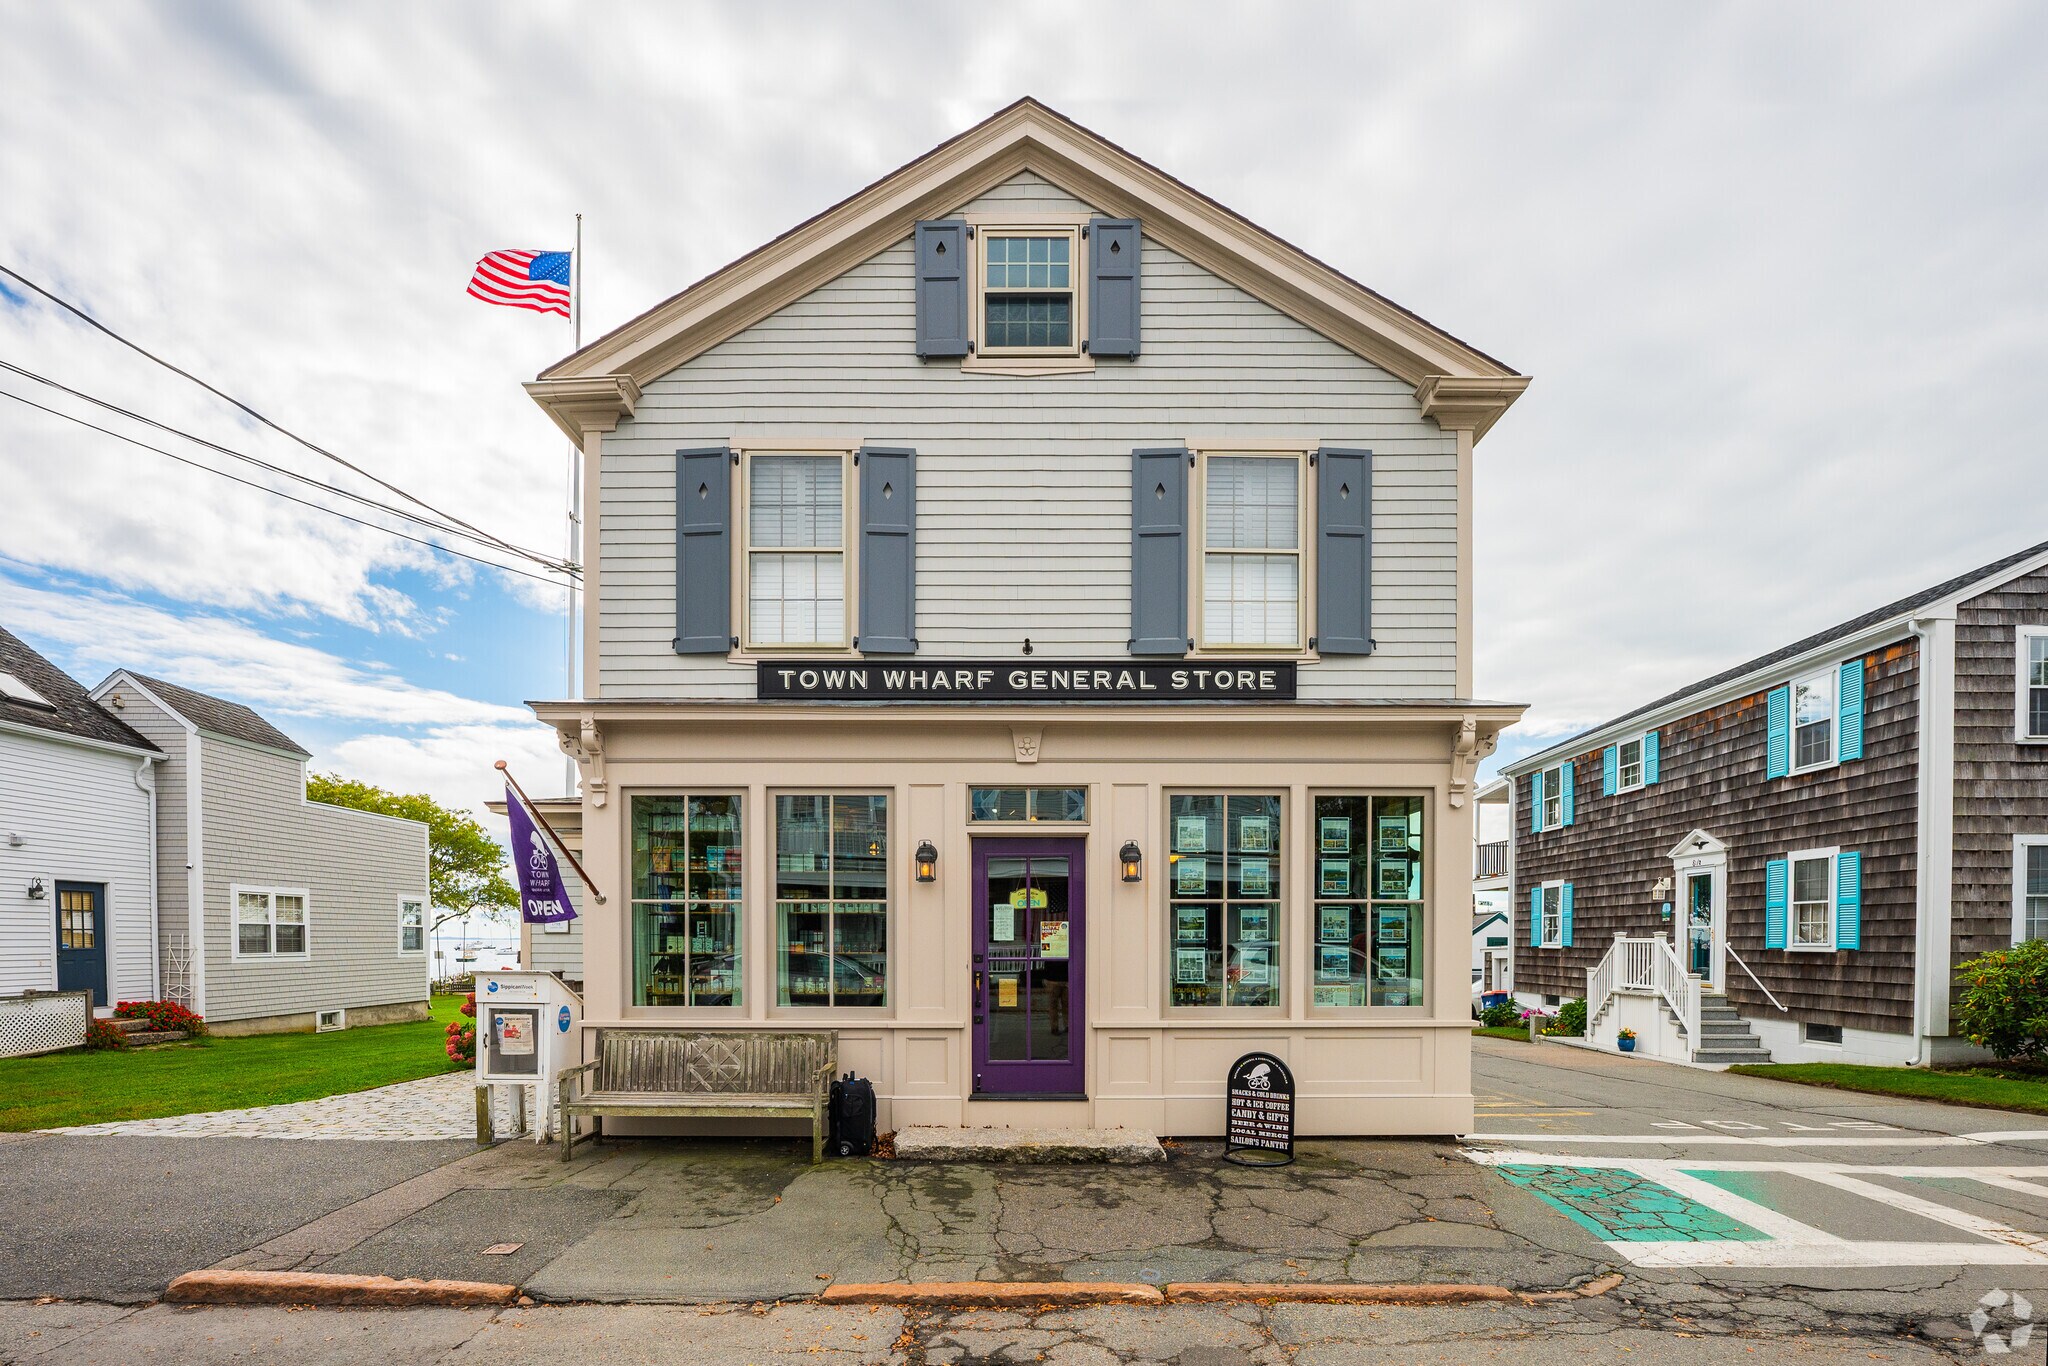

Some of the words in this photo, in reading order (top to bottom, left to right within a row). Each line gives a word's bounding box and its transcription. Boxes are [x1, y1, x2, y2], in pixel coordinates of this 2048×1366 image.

[778, 670, 869, 690] TOWN
[883, 670, 995, 690] WHARF
[1007, 670, 1158, 690] GENERAL
[1171, 670, 1278, 690] STORE
[531, 871, 550, 879] TOWN
[528, 899, 565, 916] OPEN
[1231, 1089, 1252, 1097] SNACKS
[1270, 1092, 1290, 1100] DRINKS
[1231, 1099, 1245, 1107] HOT
[1246, 1099, 1252, 1107] &
[1253, 1100, 1264, 1108] ICE
[1265, 1101, 1290, 1111] COFFEE
[1231, 1109, 1257, 1119] CANDY
[1258, 1111, 1265, 1120] &
[1266, 1112, 1289, 1122] GIFTS
[1264, 1123, 1289, 1131] WINE
[1258, 1131, 1289, 1139] MERCH
[1230, 1136, 1260, 1146] SAILOR'S
[1260, 1139, 1289, 1150] PANTRY
